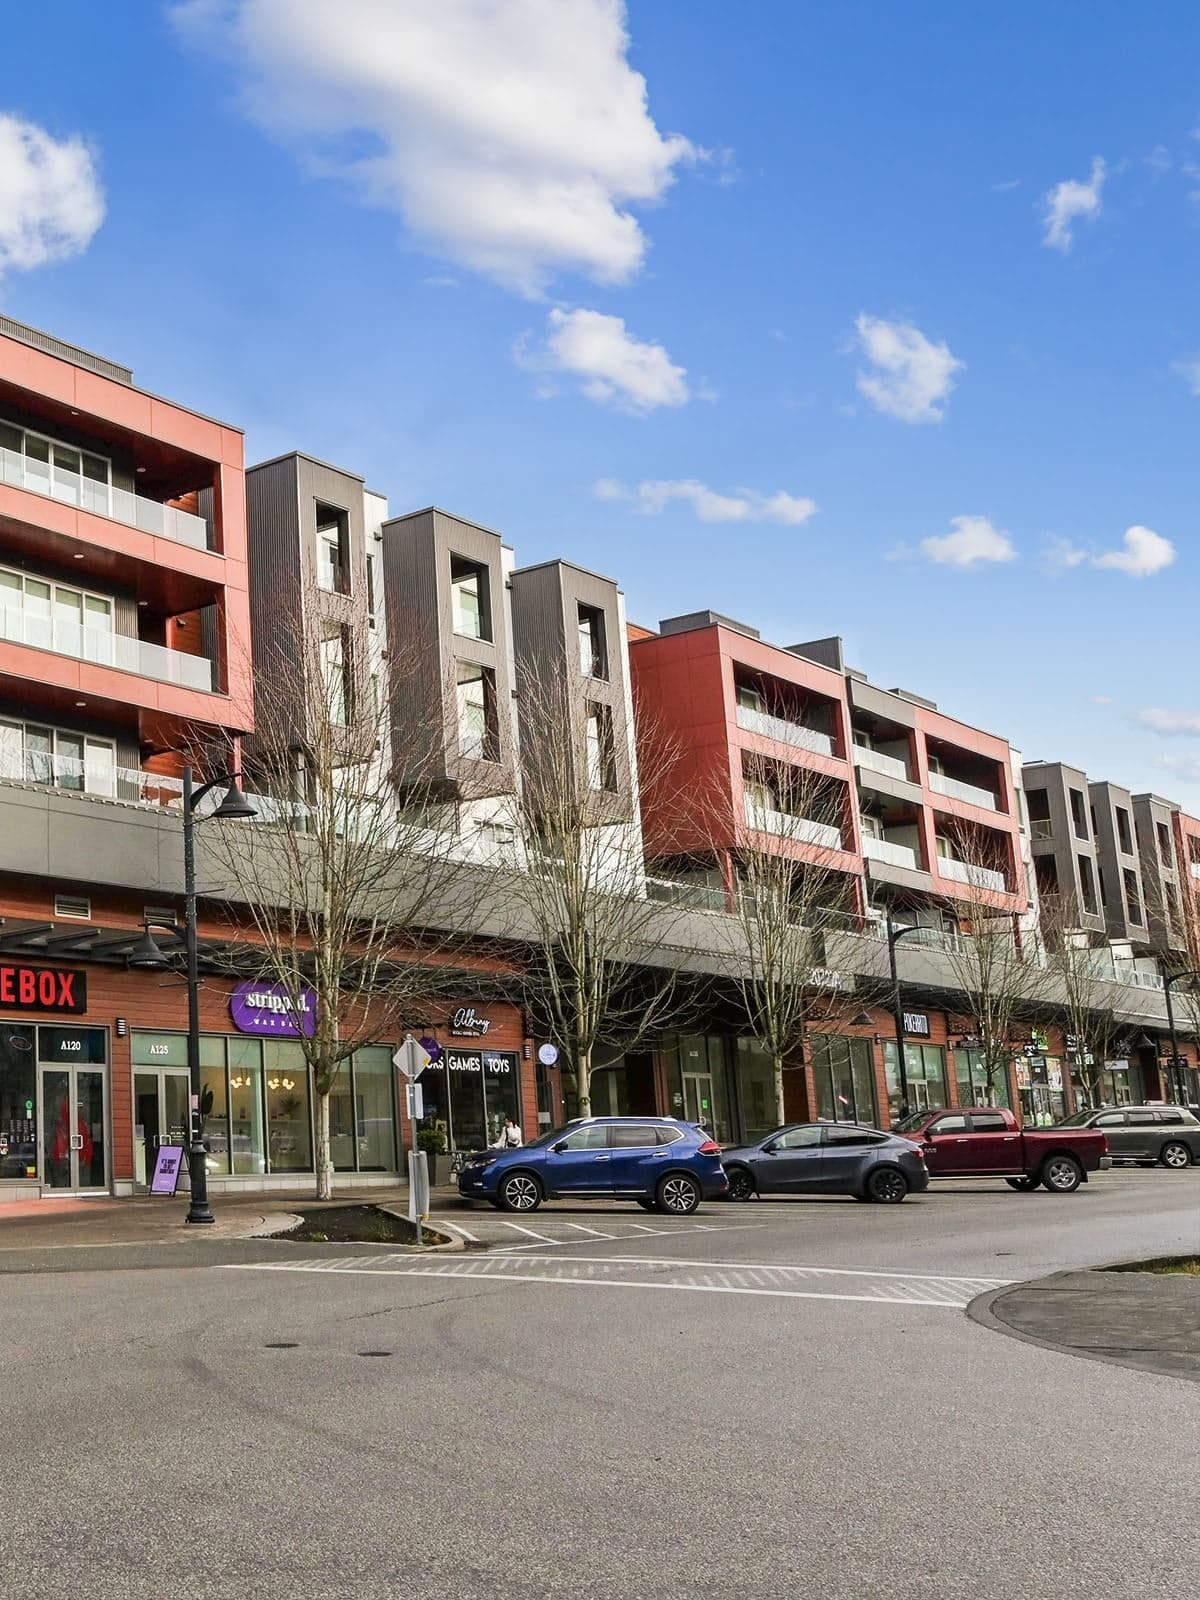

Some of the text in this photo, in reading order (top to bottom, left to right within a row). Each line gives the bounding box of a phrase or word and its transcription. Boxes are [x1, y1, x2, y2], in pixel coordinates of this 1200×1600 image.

[61, 1040, 81, 1051] A120
[150, 1045, 168, 1055] A125
[449, 1056, 480, 1072] GAMES
[488, 1058, 510, 1073] TOYS
